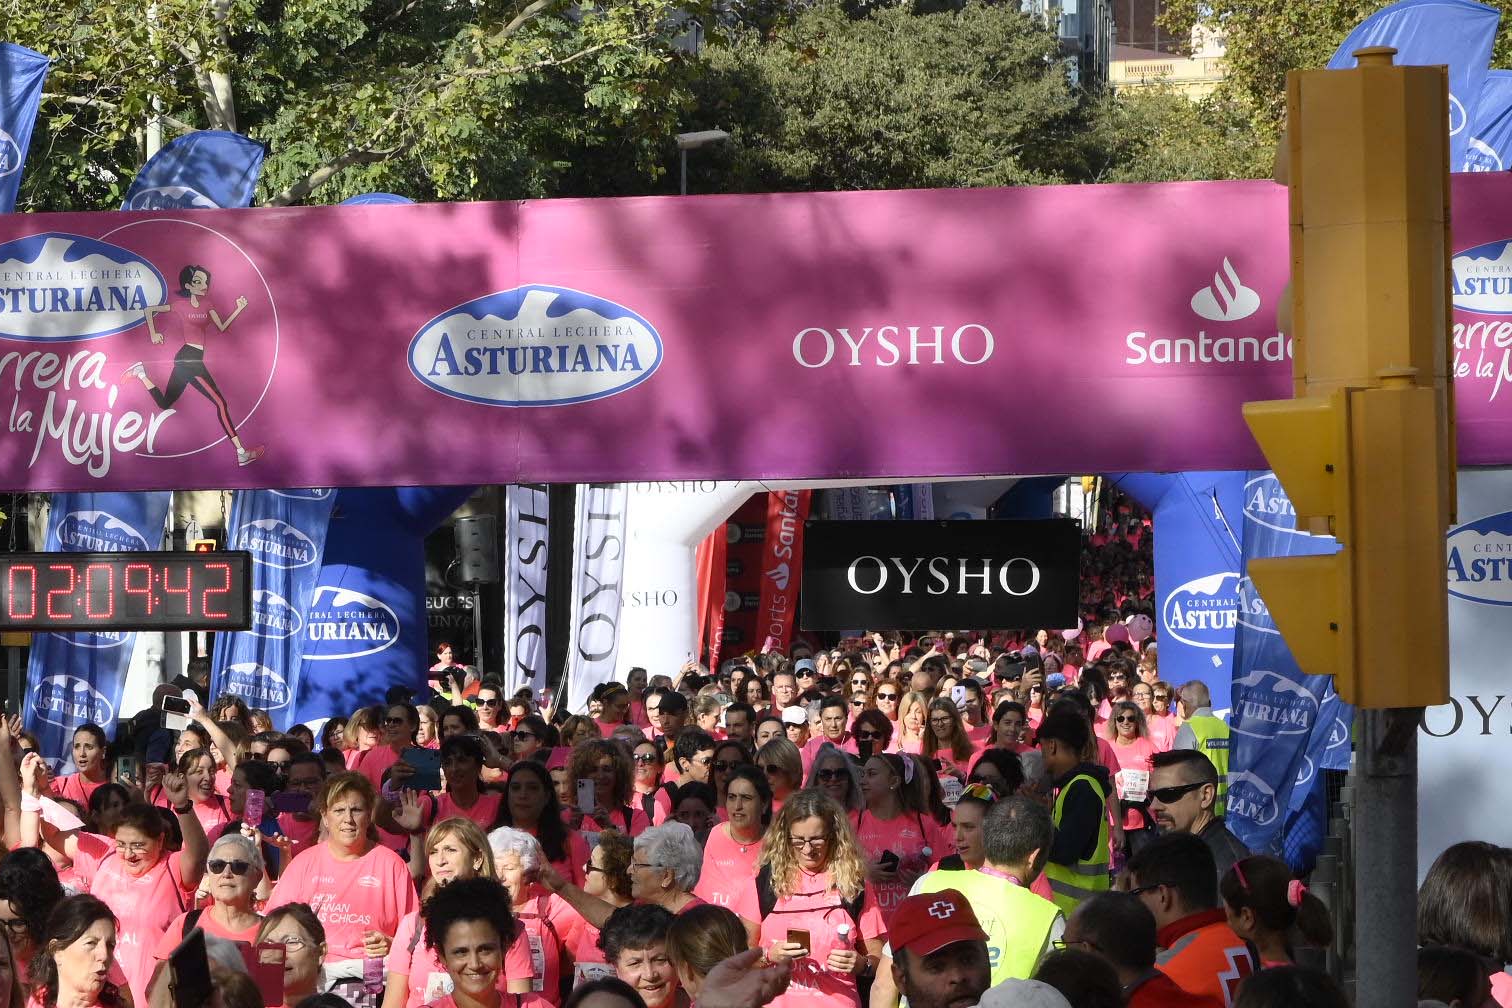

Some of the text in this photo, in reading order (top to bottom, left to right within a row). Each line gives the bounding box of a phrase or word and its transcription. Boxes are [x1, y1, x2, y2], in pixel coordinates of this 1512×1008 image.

[70, 269, 142, 281] LECHERA
[1466, 264, 1512, 274] CENTRA
[467, 325, 635, 341] CENTRAL LECHERA
[792, 325, 995, 368] OYSHO
[427, 331, 643, 377] ASTURIANA
[8, 394, 33, 433] la
[28, 384, 177, 478] Mujer
[516, 484, 550, 679] OYSH
[578, 484, 622, 662] OYSH
[847, 555, 1040, 596] OYSHO
[8, 563, 230, 619] 02:09:42
[308, 622, 391, 641] URIANA
[1170, 601, 1238, 630] ASTUR
[712, 892, 729, 905] TU
[329, 913, 372, 925] CHICAS
